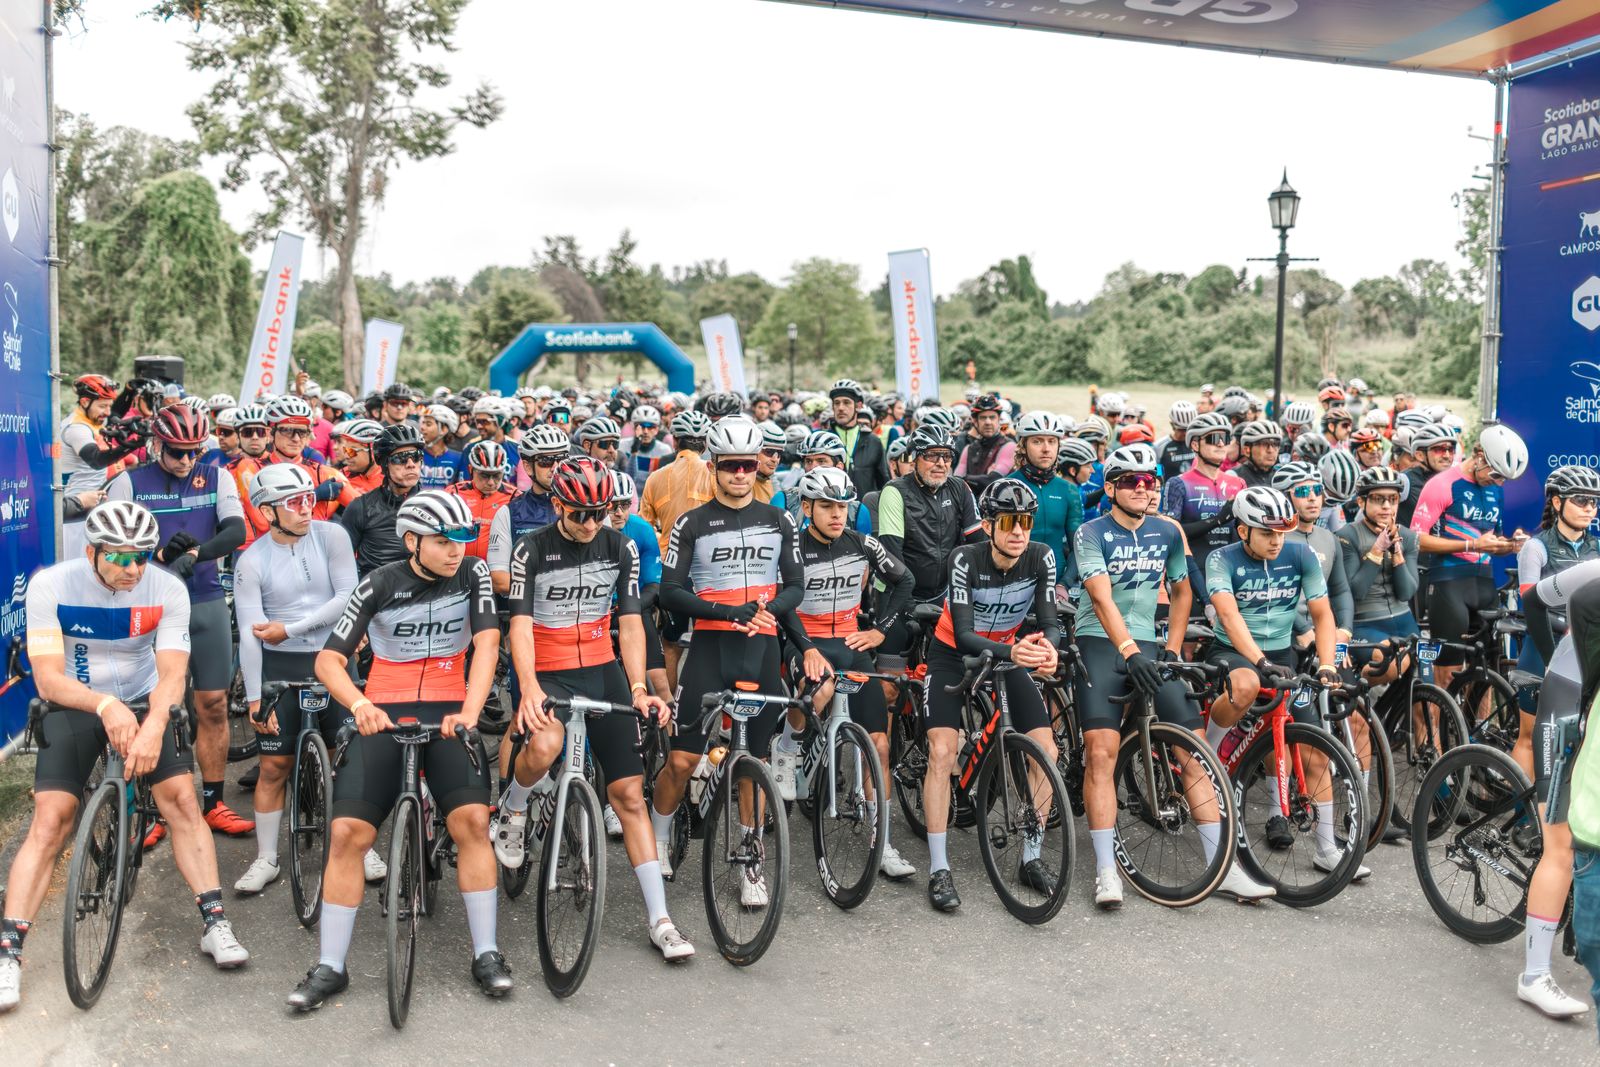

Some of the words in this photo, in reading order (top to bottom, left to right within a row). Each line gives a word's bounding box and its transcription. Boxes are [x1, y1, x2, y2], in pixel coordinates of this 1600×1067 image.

[1030, 5, 1127, 23] VUELTA
[1142, 18, 1174, 28] LA
[1541, 147, 1568, 161] LAGO
[544, 329, 635, 347] Scotiabank
[136, 493, 180, 502] FUNBIKERS
[663, 512, 689, 570] BMC
[711, 545, 775, 563] BMC
[864, 534, 895, 574] BMC
[509, 542, 530, 601] BMC
[1042, 547, 1057, 605] BMC
[1107, 558, 1165, 575] cycling
[472, 558, 497, 615] BMC
[805, 573, 861, 591] BMC
[951, 551, 970, 605] BMC
[546, 583, 611, 601] BMC
[1235, 586, 1298, 602] cycling
[333, 577, 374, 641] BMC
[973, 599, 1027, 615] BMC
[393, 617, 465, 638] BMC
[306, 699, 323, 707] 557
[738, 706, 757, 715] 733
[1000, 690, 1009, 713] BMC
[572, 733, 583, 769] BMC
[1542, 726, 1551, 776] PERFORMANCE
[406, 752, 415, 785] BMC
[1190, 751, 1227, 818] roval
[1344, 778, 1359, 853] roval
[1467, 846, 1511, 876] SPECIALIZED
